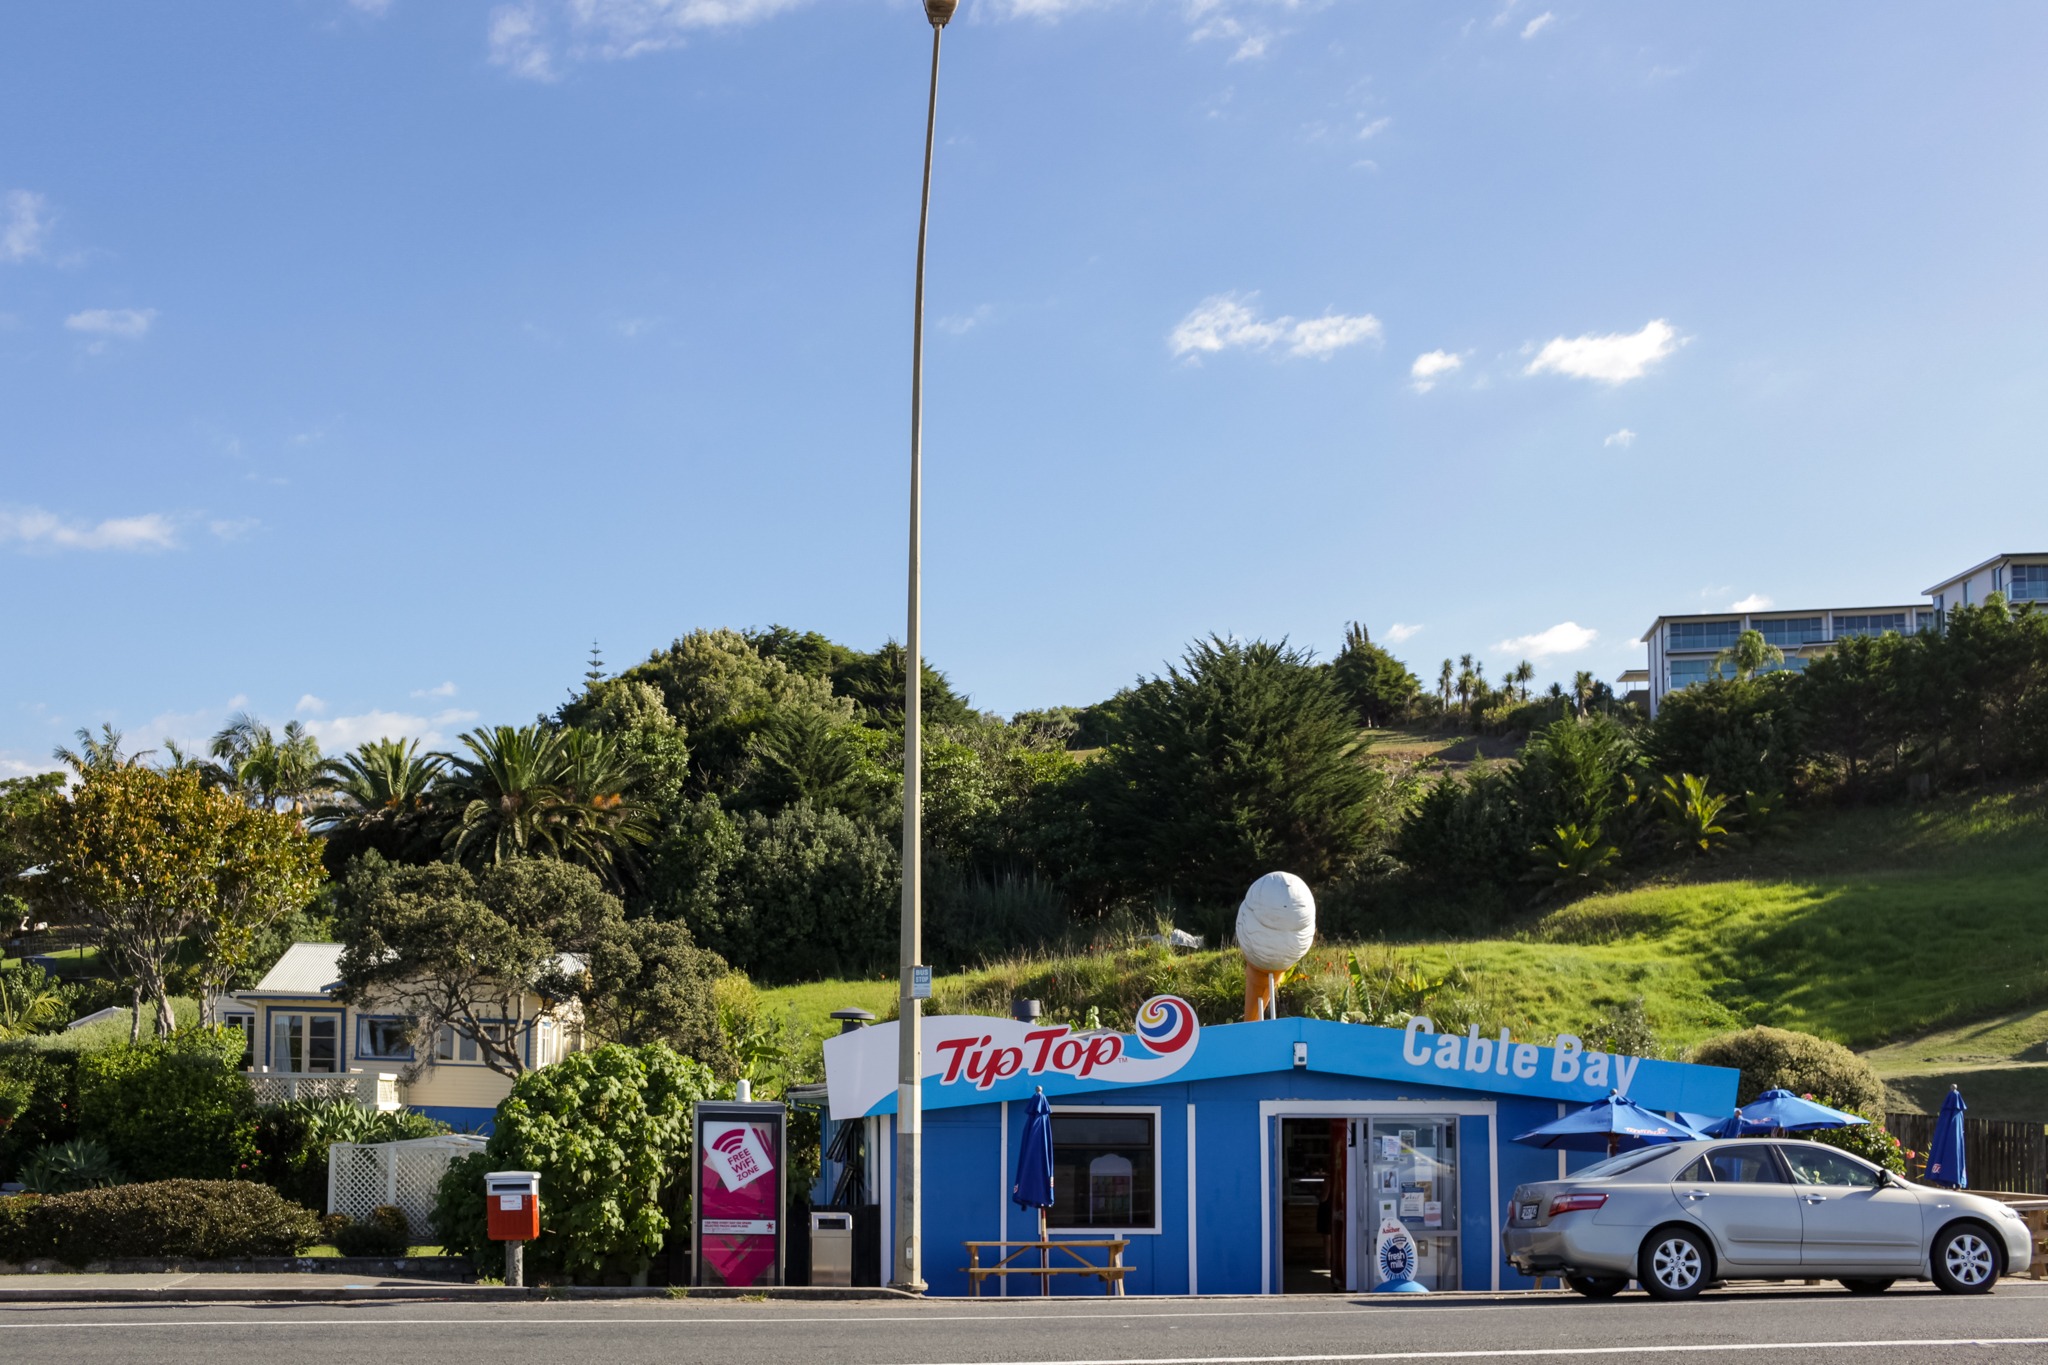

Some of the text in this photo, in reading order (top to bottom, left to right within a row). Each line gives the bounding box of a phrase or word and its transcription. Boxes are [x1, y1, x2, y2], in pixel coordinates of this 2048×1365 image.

[1403, 1016, 1640, 1096] Cable Bay
[728, 1149, 750, 1165] FREE
[731, 1156, 755, 1173] WiFi
[737, 1165, 759, 1181] ZONE
[1388, 1251, 1405, 1261] fresh
[1391, 1259, 1404, 1268] milk
